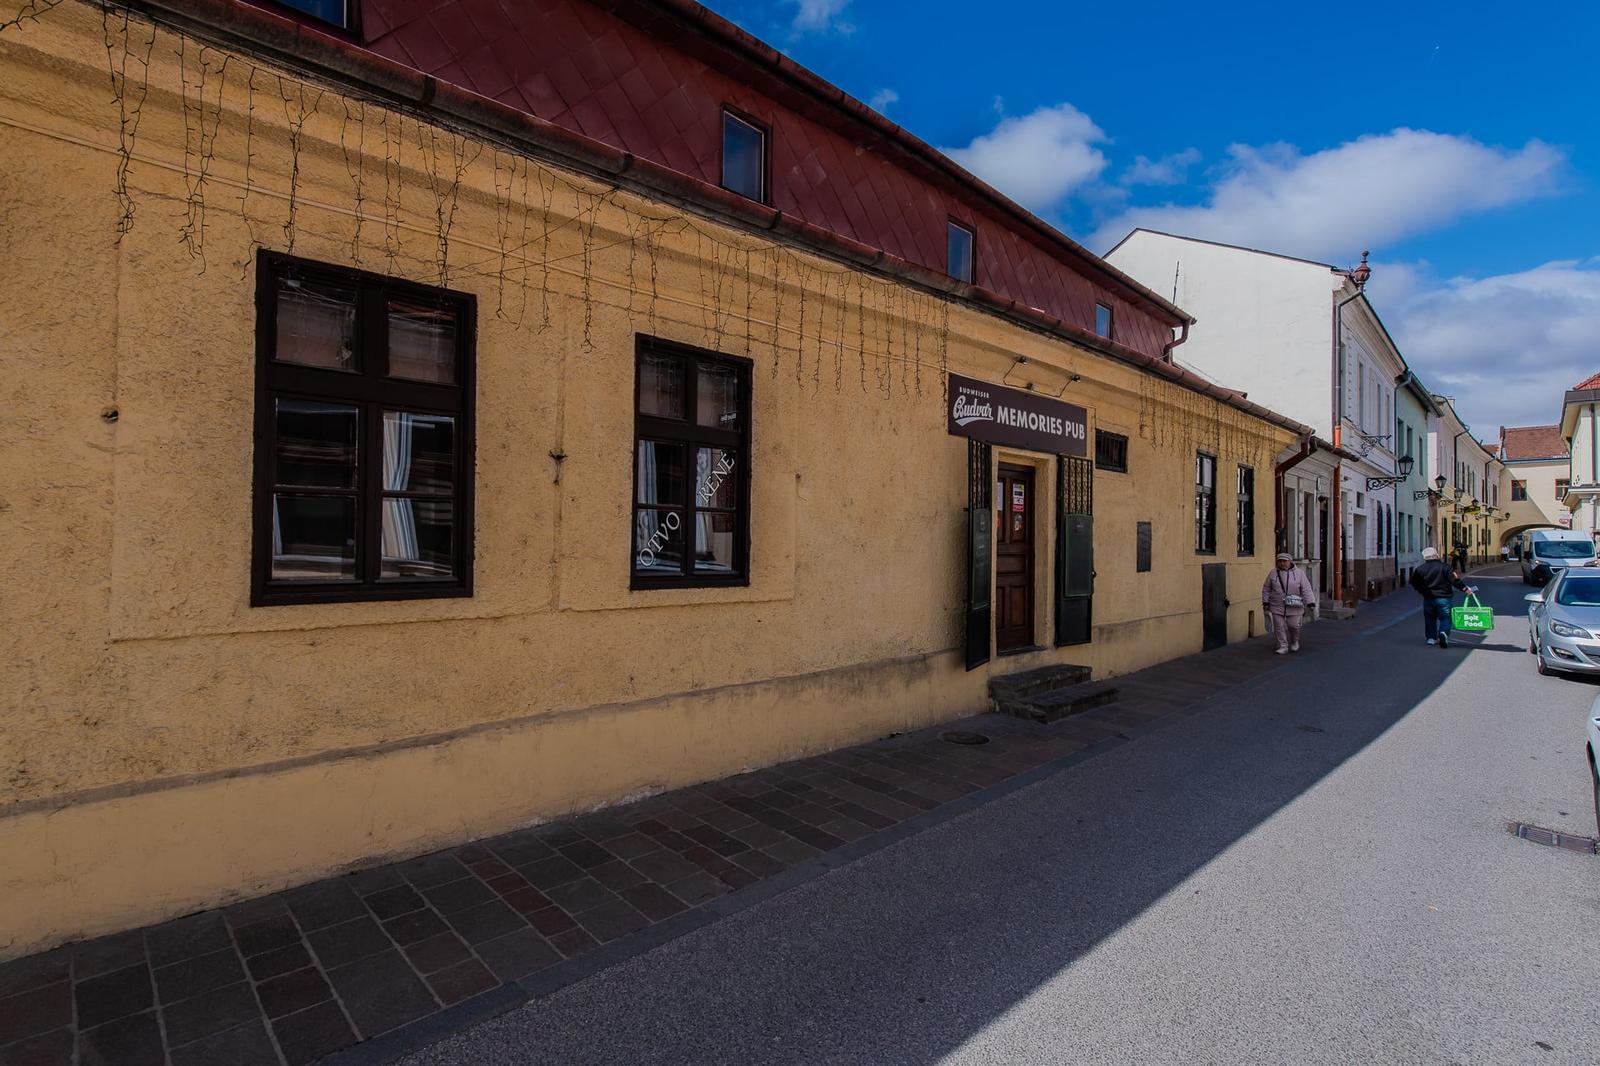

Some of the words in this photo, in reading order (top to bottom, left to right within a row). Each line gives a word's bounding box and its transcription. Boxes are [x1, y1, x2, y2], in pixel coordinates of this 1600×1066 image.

[959, 386, 990, 398] BUDWEISER
[997, 405, 1063, 436] MEMORIES
[1065, 420, 1085, 440] PUB
[639, 511, 681, 567] OTVO
